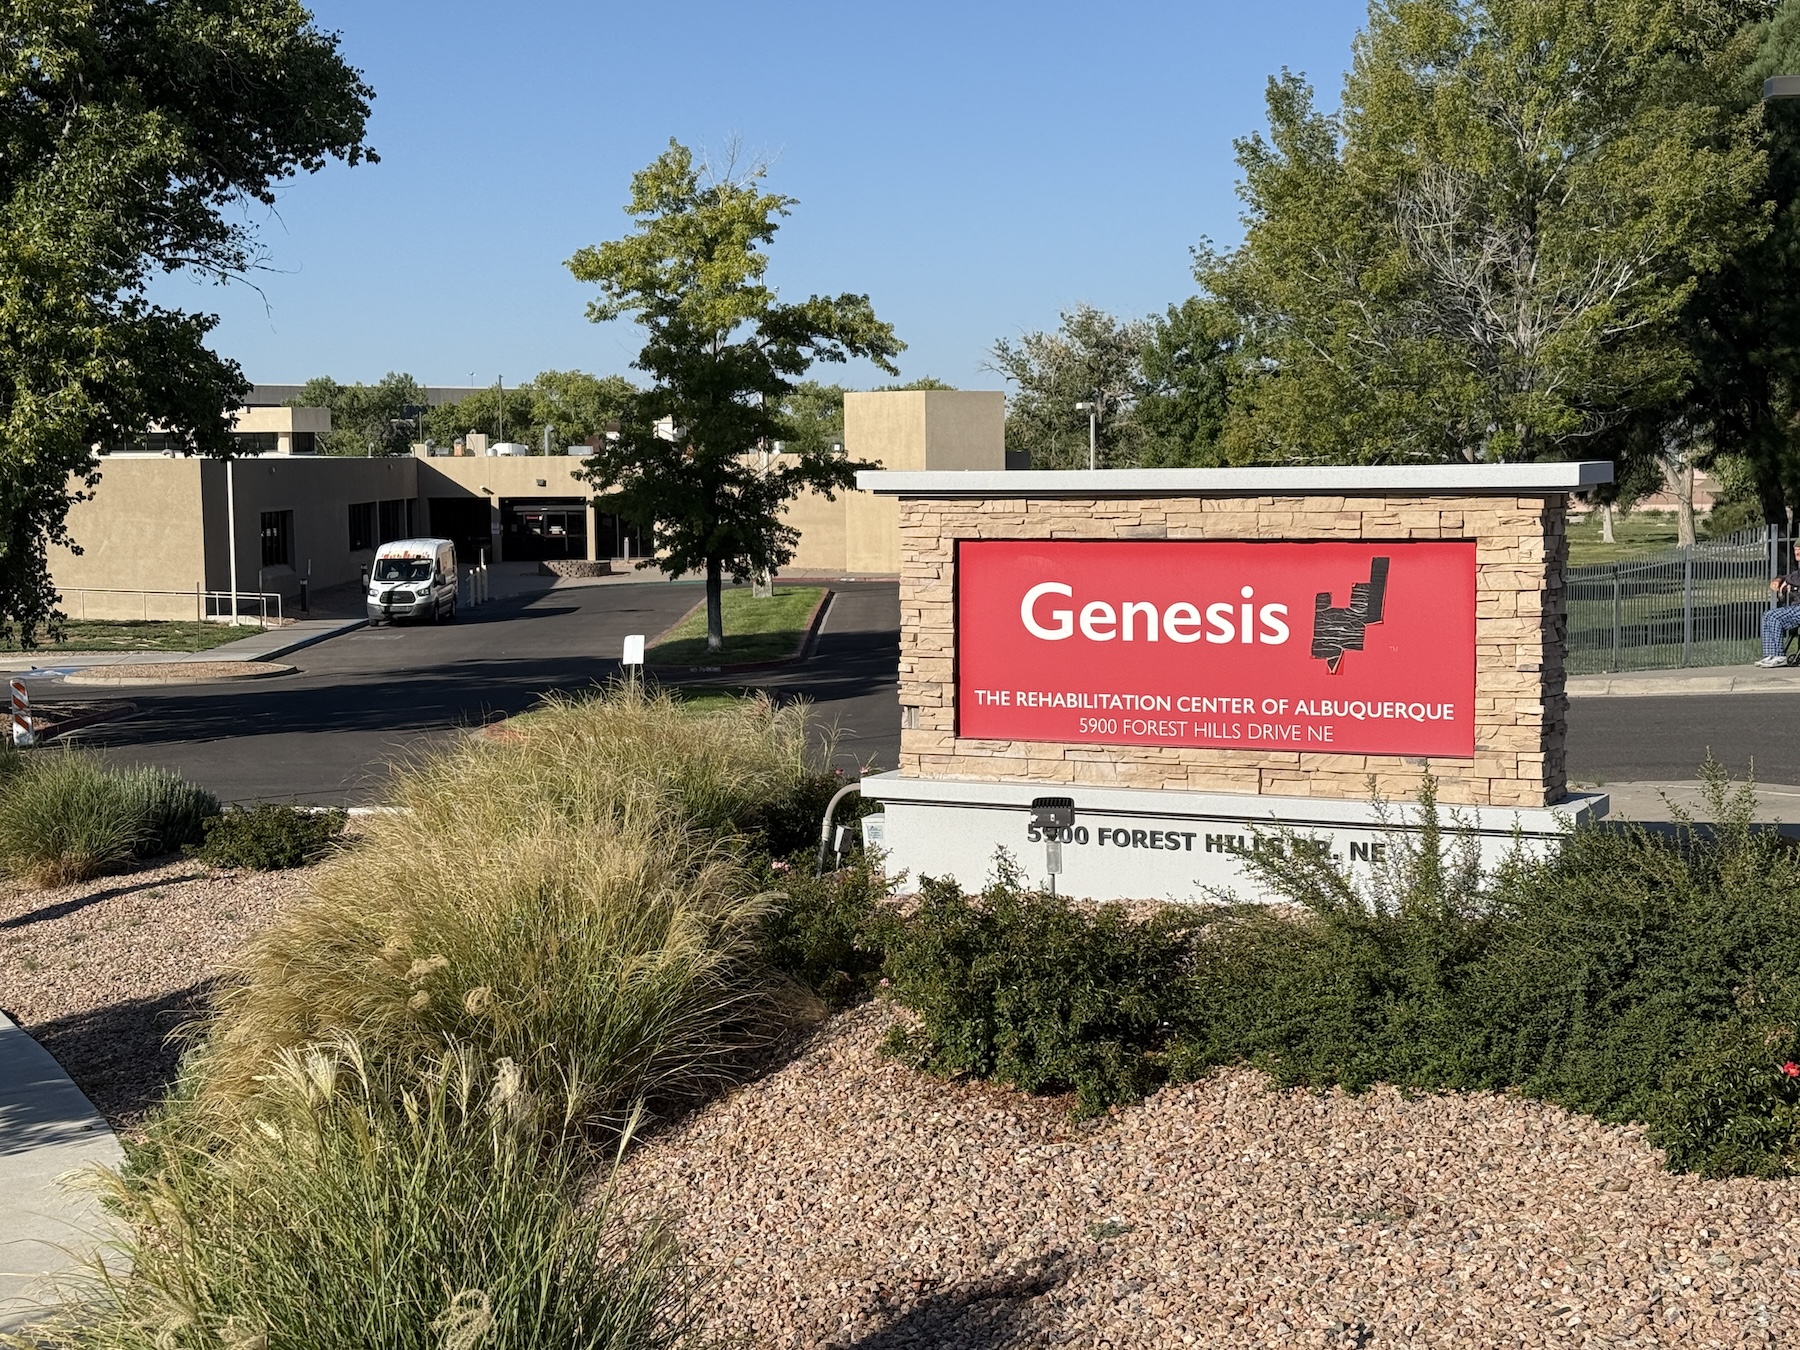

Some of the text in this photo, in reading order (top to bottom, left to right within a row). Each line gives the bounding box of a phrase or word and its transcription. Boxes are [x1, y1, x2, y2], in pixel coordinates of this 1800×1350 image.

[1020, 581, 1290, 645] Genesis
[973, 689, 1455, 723] THE REHABILITATION CENTER OF ALBUQUERQUE
[1079, 717, 1334, 742] 5900 FOREST HILLS DRIVE NE
[1027, 823, 1089, 845] 500
[1098, 827, 1197, 851] FOREST
[1350, 841, 1386, 863] NE
